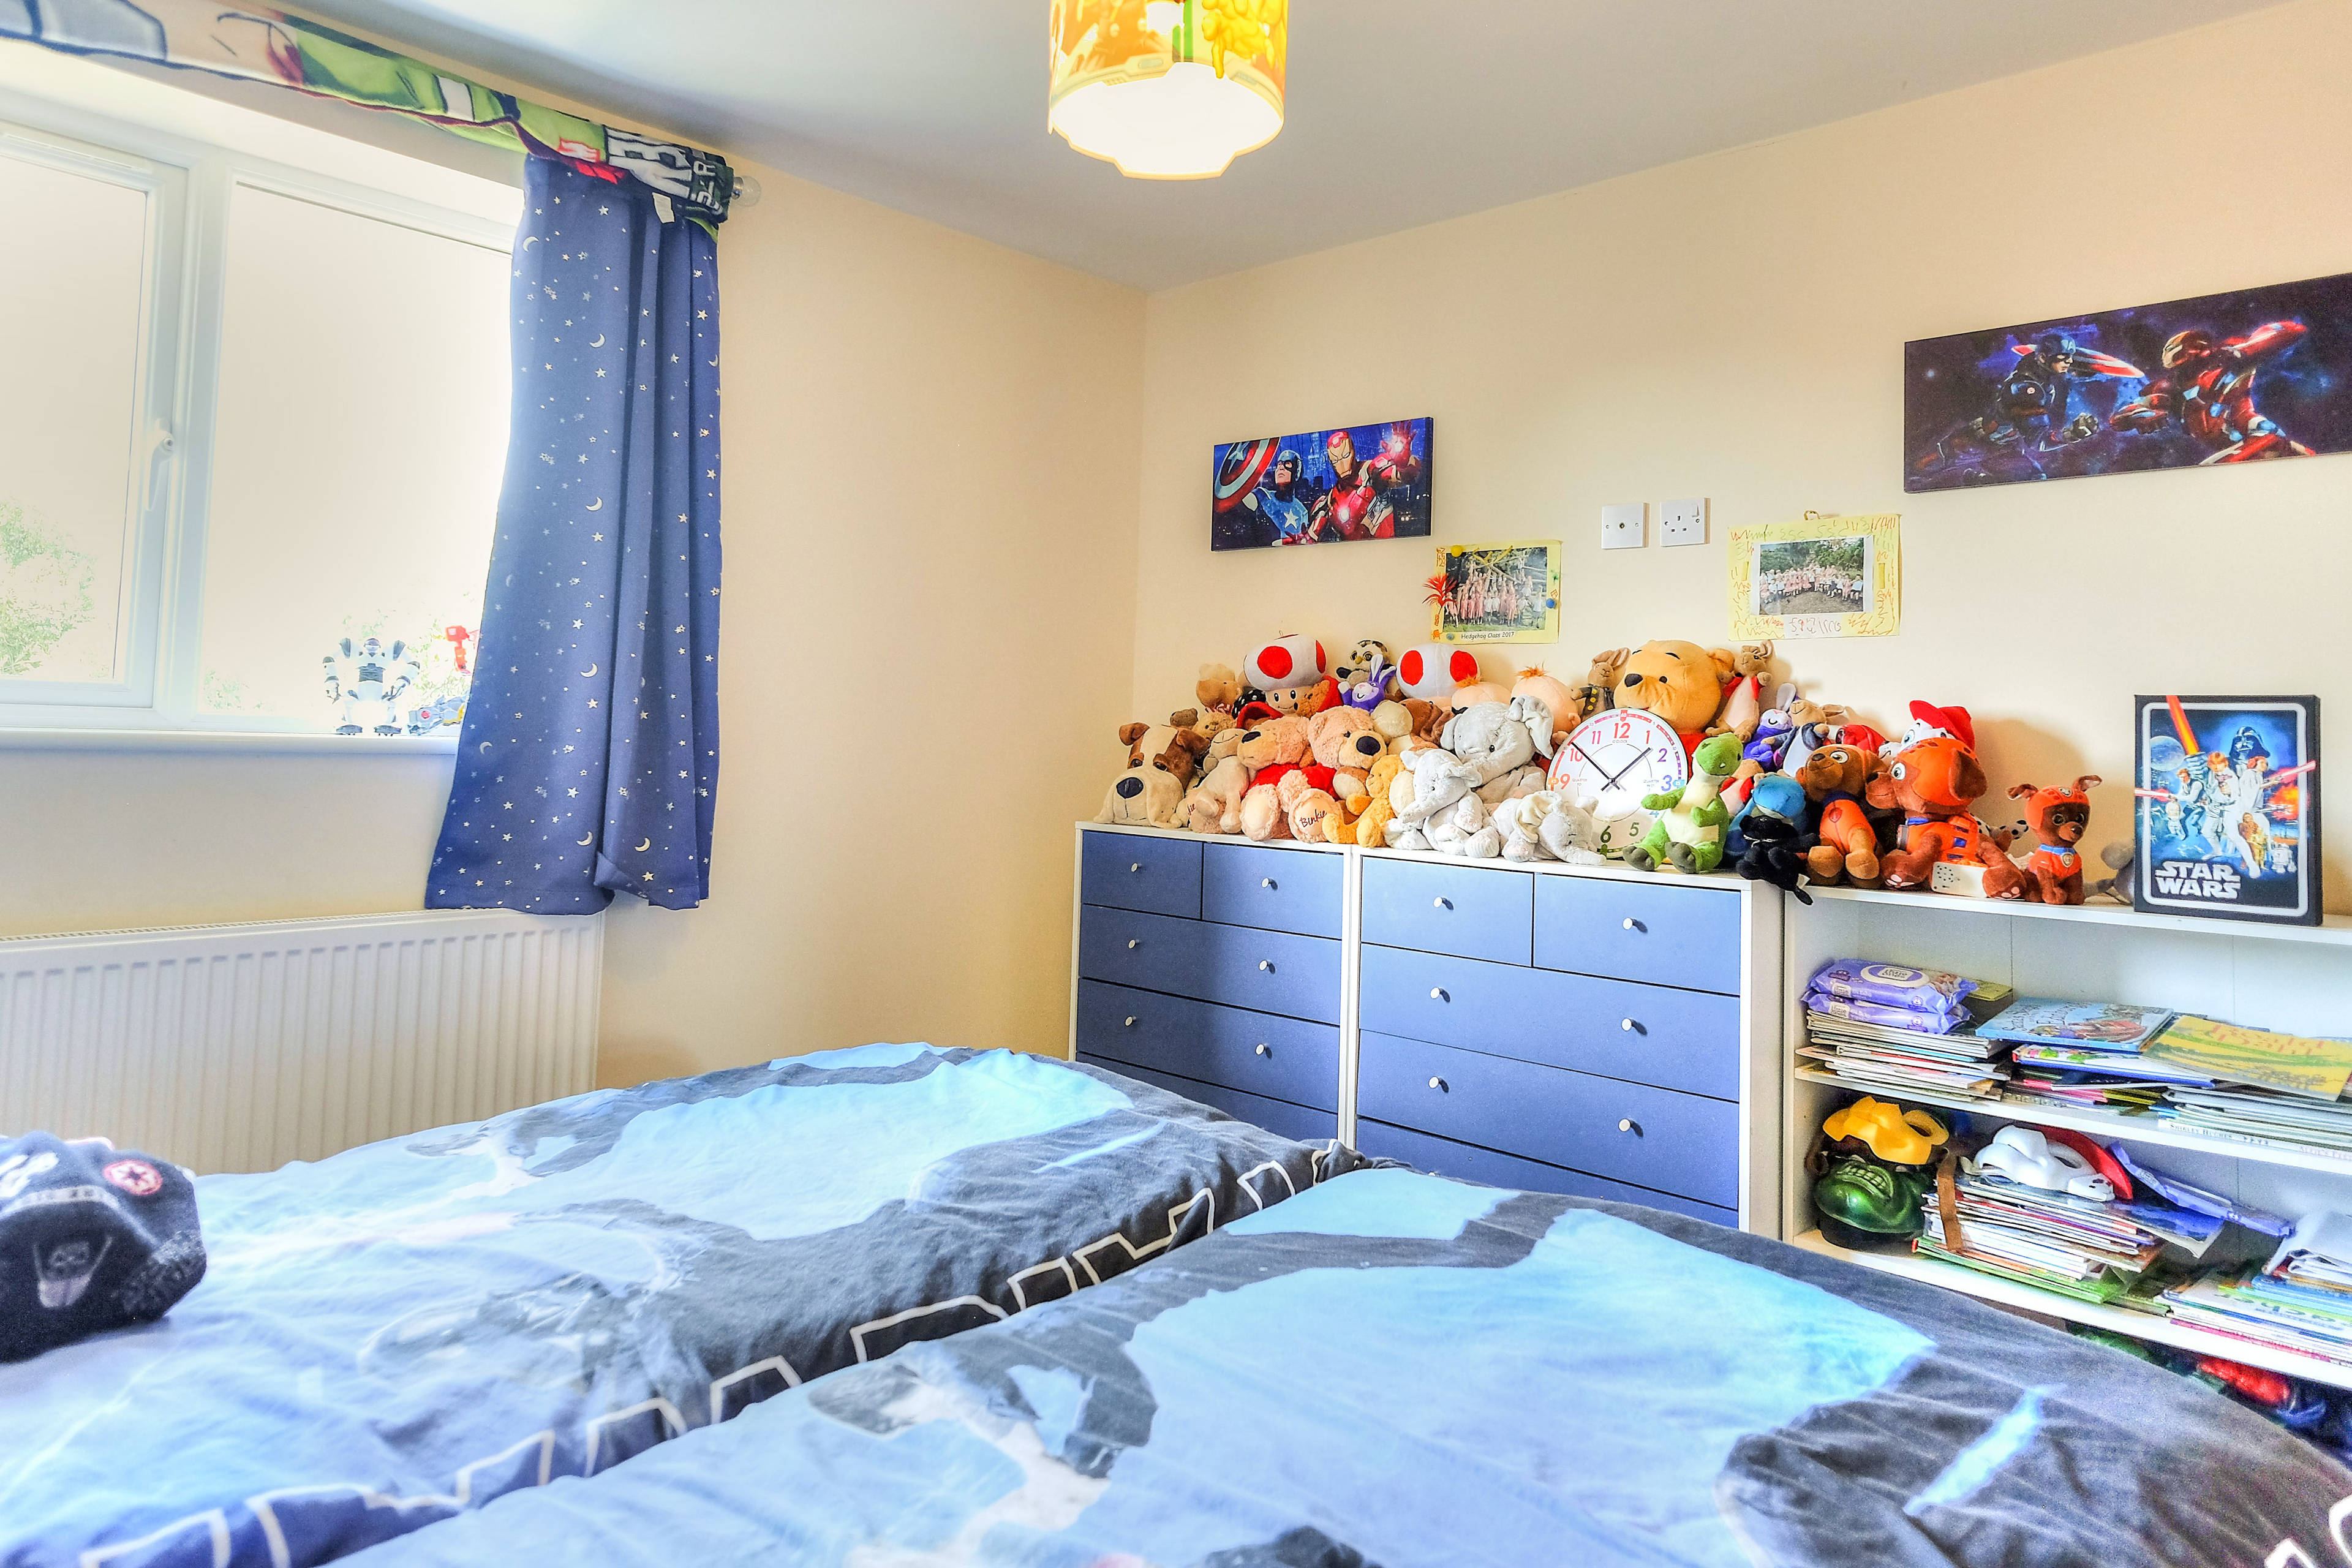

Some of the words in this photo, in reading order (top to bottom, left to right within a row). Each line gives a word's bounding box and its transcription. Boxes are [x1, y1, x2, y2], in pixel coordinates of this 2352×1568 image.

[1592, 731, 1601, 744] 11
[1613, 723, 1630, 739] 12
[1646, 730, 1650, 744] 1
[1570, 748, 1583, 762] 10
[1657, 748, 1667, 762] 2
[1560, 774, 1570, 790] 9
[1661, 775, 1672, 791] 3
[1300, 809, 1327, 827] Binkie
[1600, 825, 1611, 843] 6
[1629, 822, 1640, 837] 5
[2155, 861, 2241, 882] STAR
[2155, 876, 2241, 899] WARS
